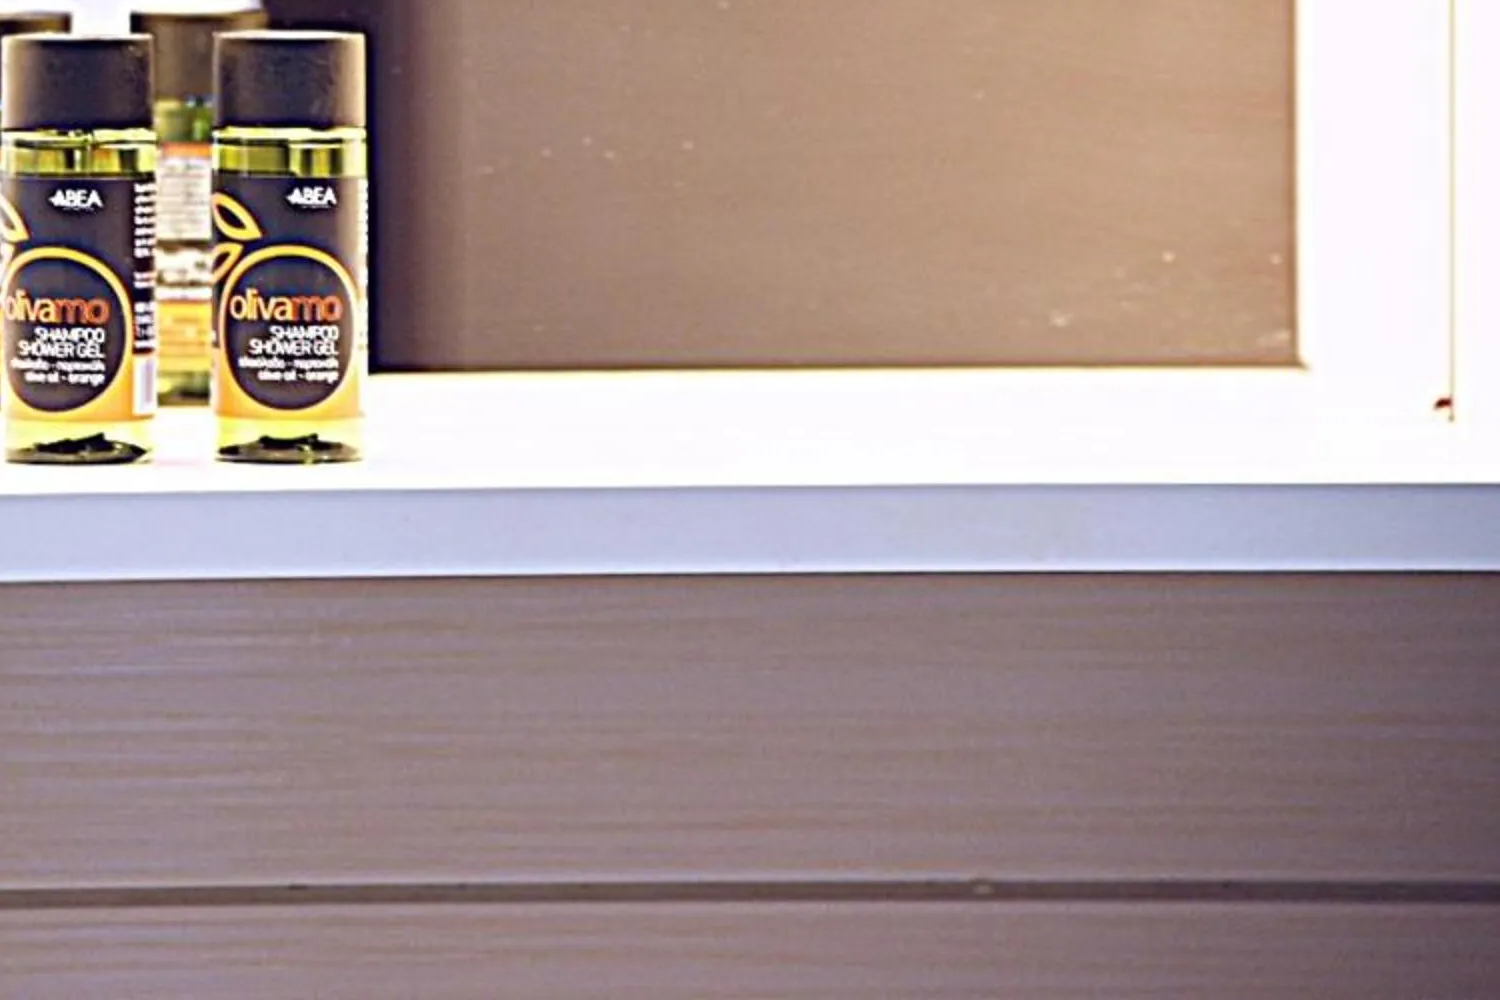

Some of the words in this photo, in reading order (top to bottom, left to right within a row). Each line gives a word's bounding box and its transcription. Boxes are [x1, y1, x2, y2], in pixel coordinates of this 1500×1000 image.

[49, 189, 103, 207] ABEA
[286, 186, 338, 205] ABEA
[5, 288, 110, 325] olivamo
[229, 288, 343, 321] olivamo
[34, 327, 106, 343] SHAMPOO
[269, 325, 339, 340] SHAMPOO
[18, 340, 74, 357] SHOWER
[76, 341, 106, 358] GEL
[249, 338, 312, 356] SHOWER
[313, 339, 338, 356] GEL
